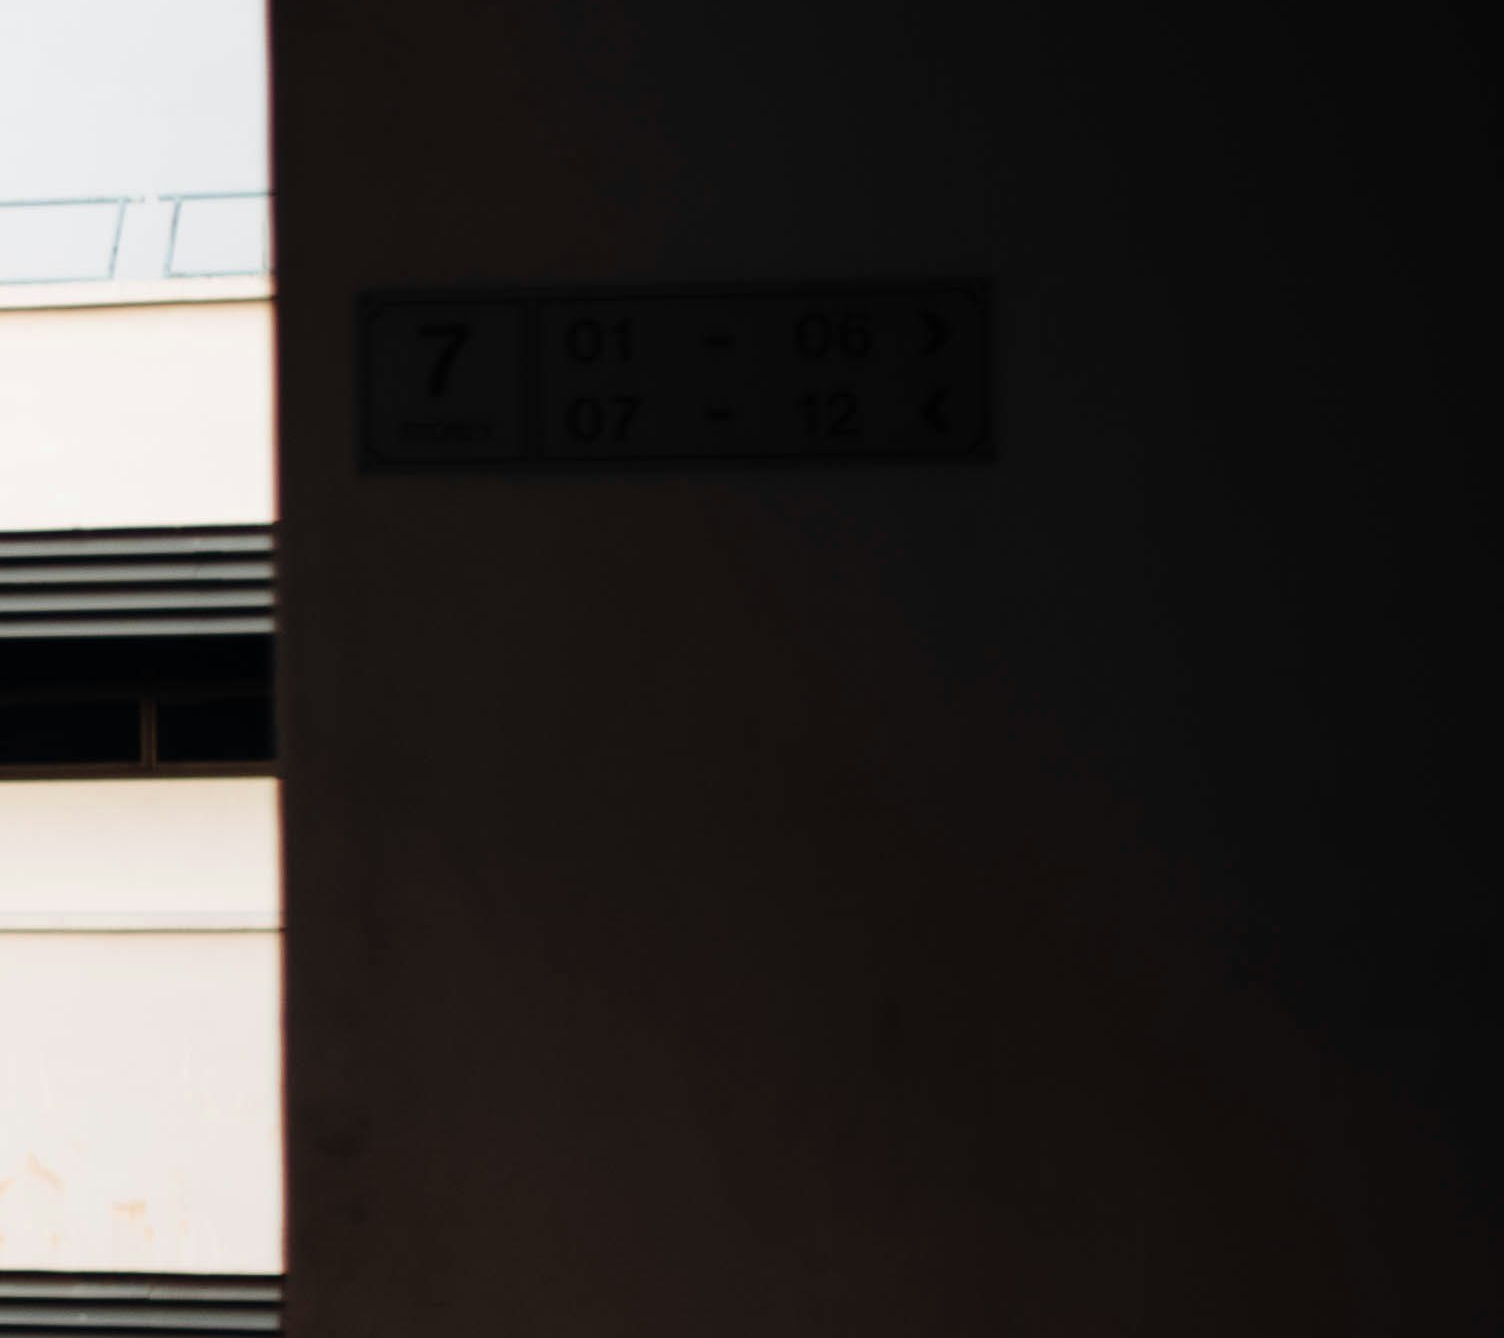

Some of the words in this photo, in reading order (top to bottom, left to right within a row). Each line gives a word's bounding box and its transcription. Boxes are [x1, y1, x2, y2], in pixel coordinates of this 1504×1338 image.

[418, 322, 470, 399] 7
[563, 317, 634, 363] 01
[793, 311, 874, 360] 06
[563, 393, 644, 443] 07
[793, 390, 859, 439] 12
